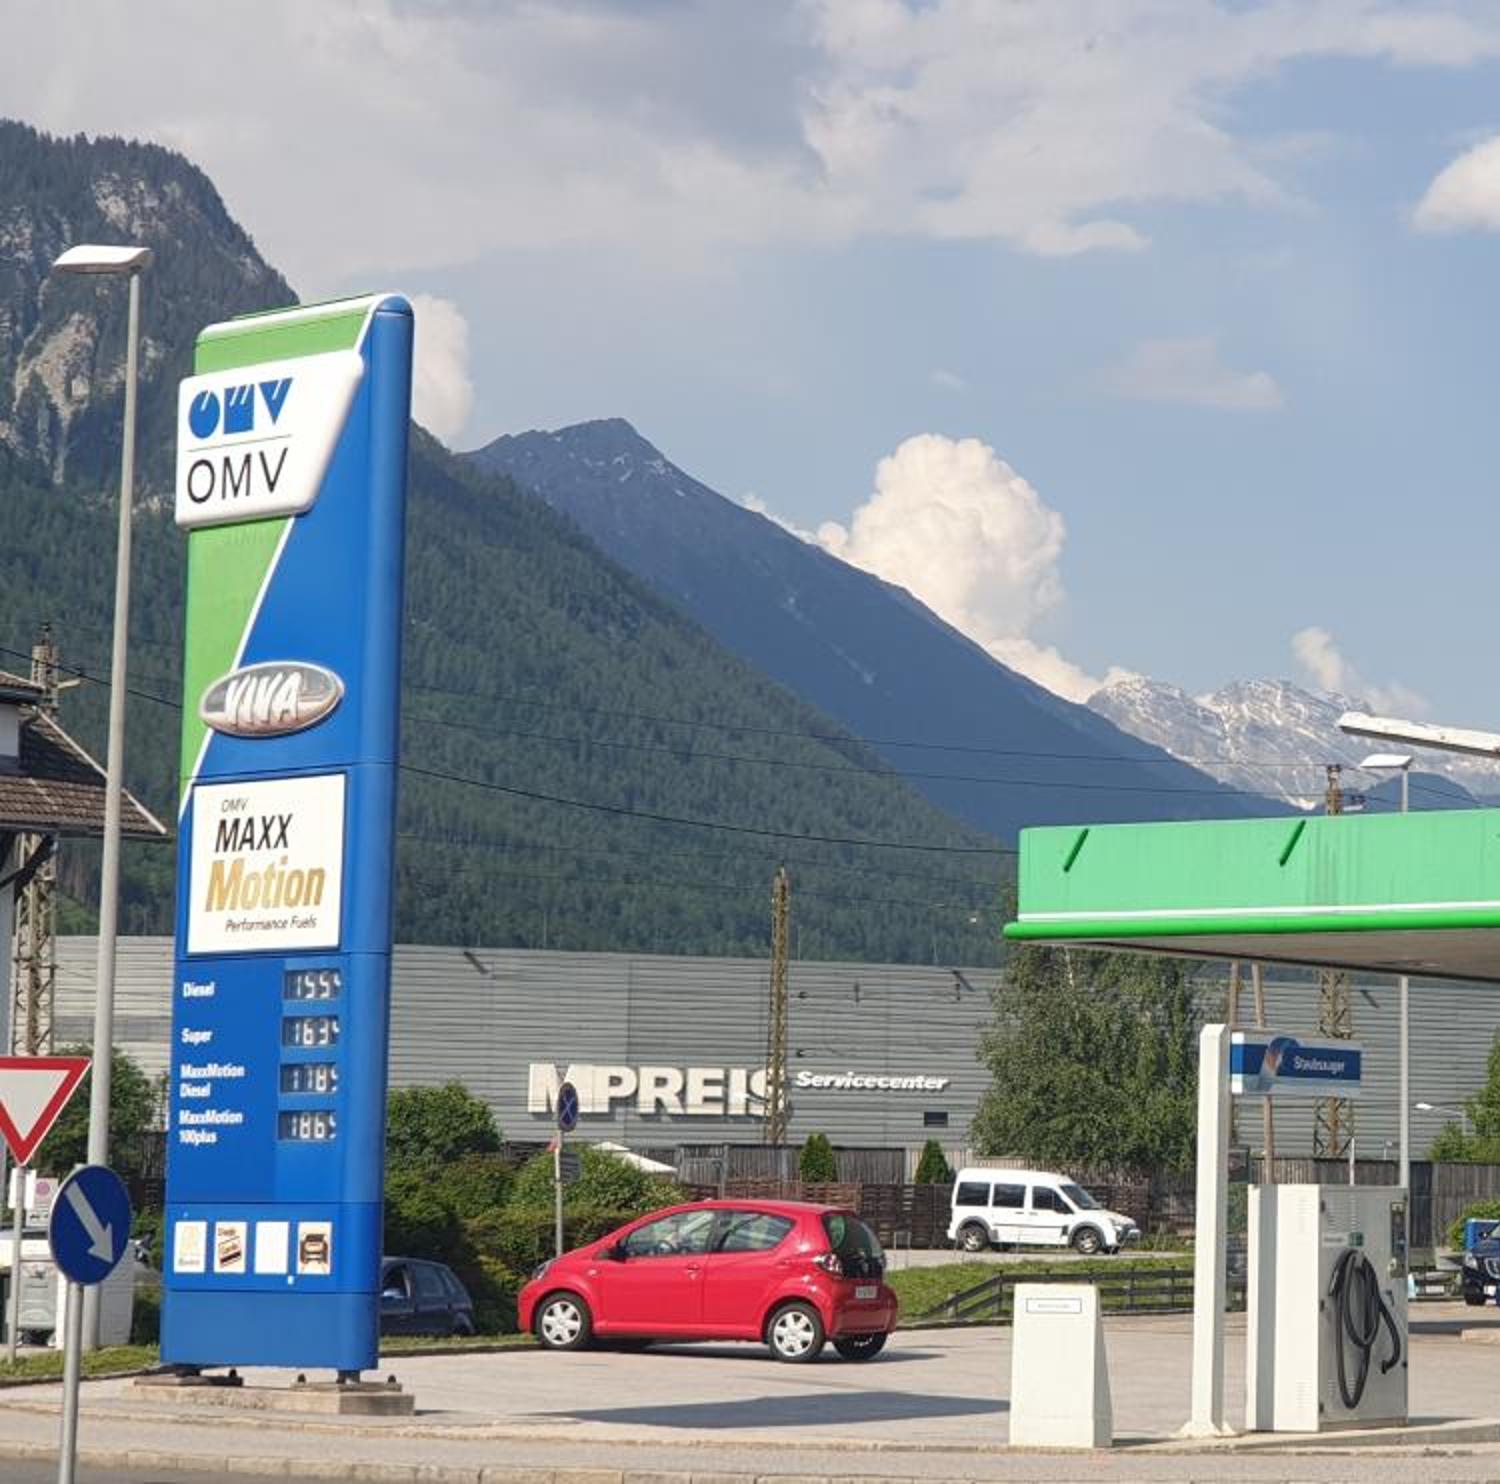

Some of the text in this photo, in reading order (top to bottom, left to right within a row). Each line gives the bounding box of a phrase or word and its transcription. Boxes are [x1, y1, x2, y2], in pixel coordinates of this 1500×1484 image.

[187, 447, 288, 504] OMV
[225, 671, 302, 727] VIVA
[221, 798, 250, 813] OMV
[215, 813, 293, 852] MAXX
[205, 856, 326, 912] Motion
[225, 914, 317, 933] Performance Fuels
[183, 981, 215, 998] Diesel
[181, 1027, 213, 1047] Super
[181, 1063, 245, 1079] MaxxMotion
[180, 1083, 211, 1097] Diesel
[528, 1063, 786, 1115] MPREIS
[797, 1071, 949, 1092] Servicecenter
[179, 1108, 243, 1125] MaxxMotion
